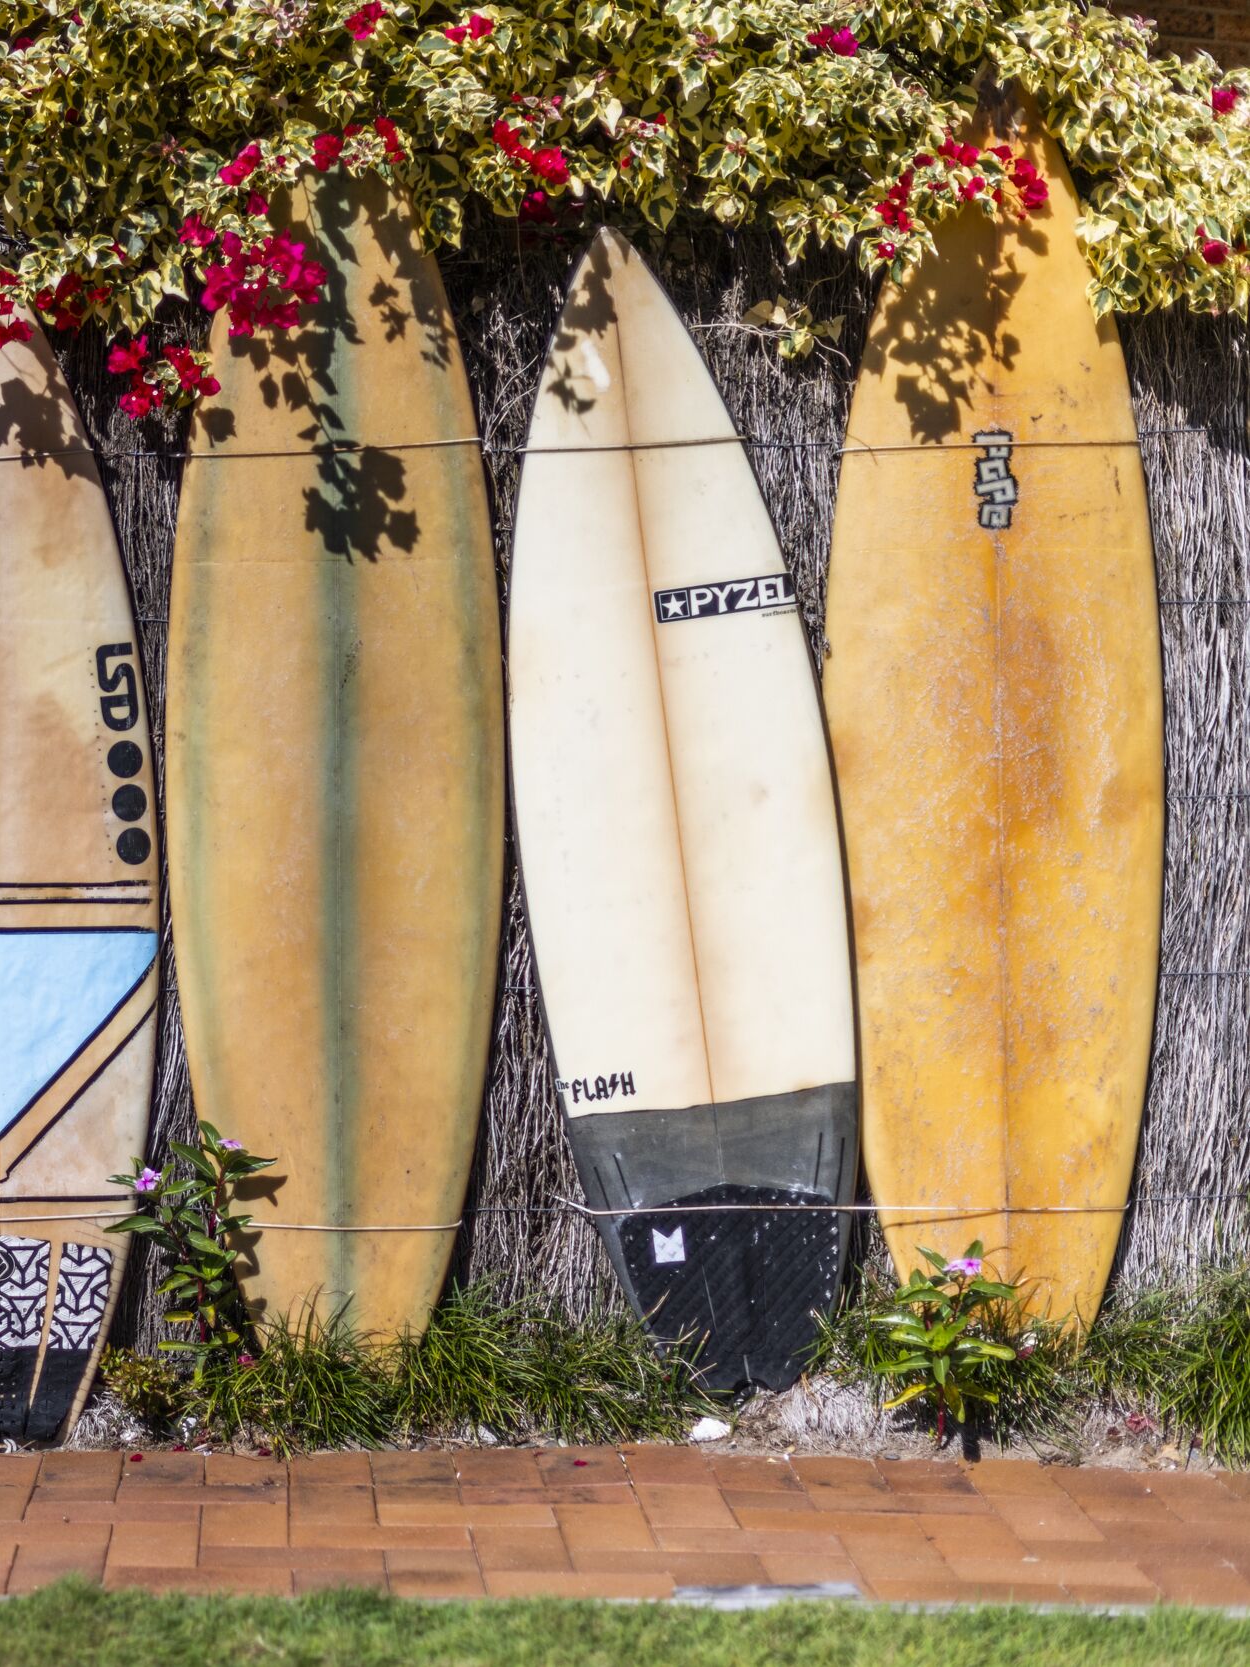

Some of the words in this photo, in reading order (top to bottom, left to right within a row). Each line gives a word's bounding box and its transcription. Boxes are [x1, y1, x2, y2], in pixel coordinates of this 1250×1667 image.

[688, 575, 796, 617] PYZEL
[95, 641, 139, 732] LSD
[556, 1080, 570, 1091] The
